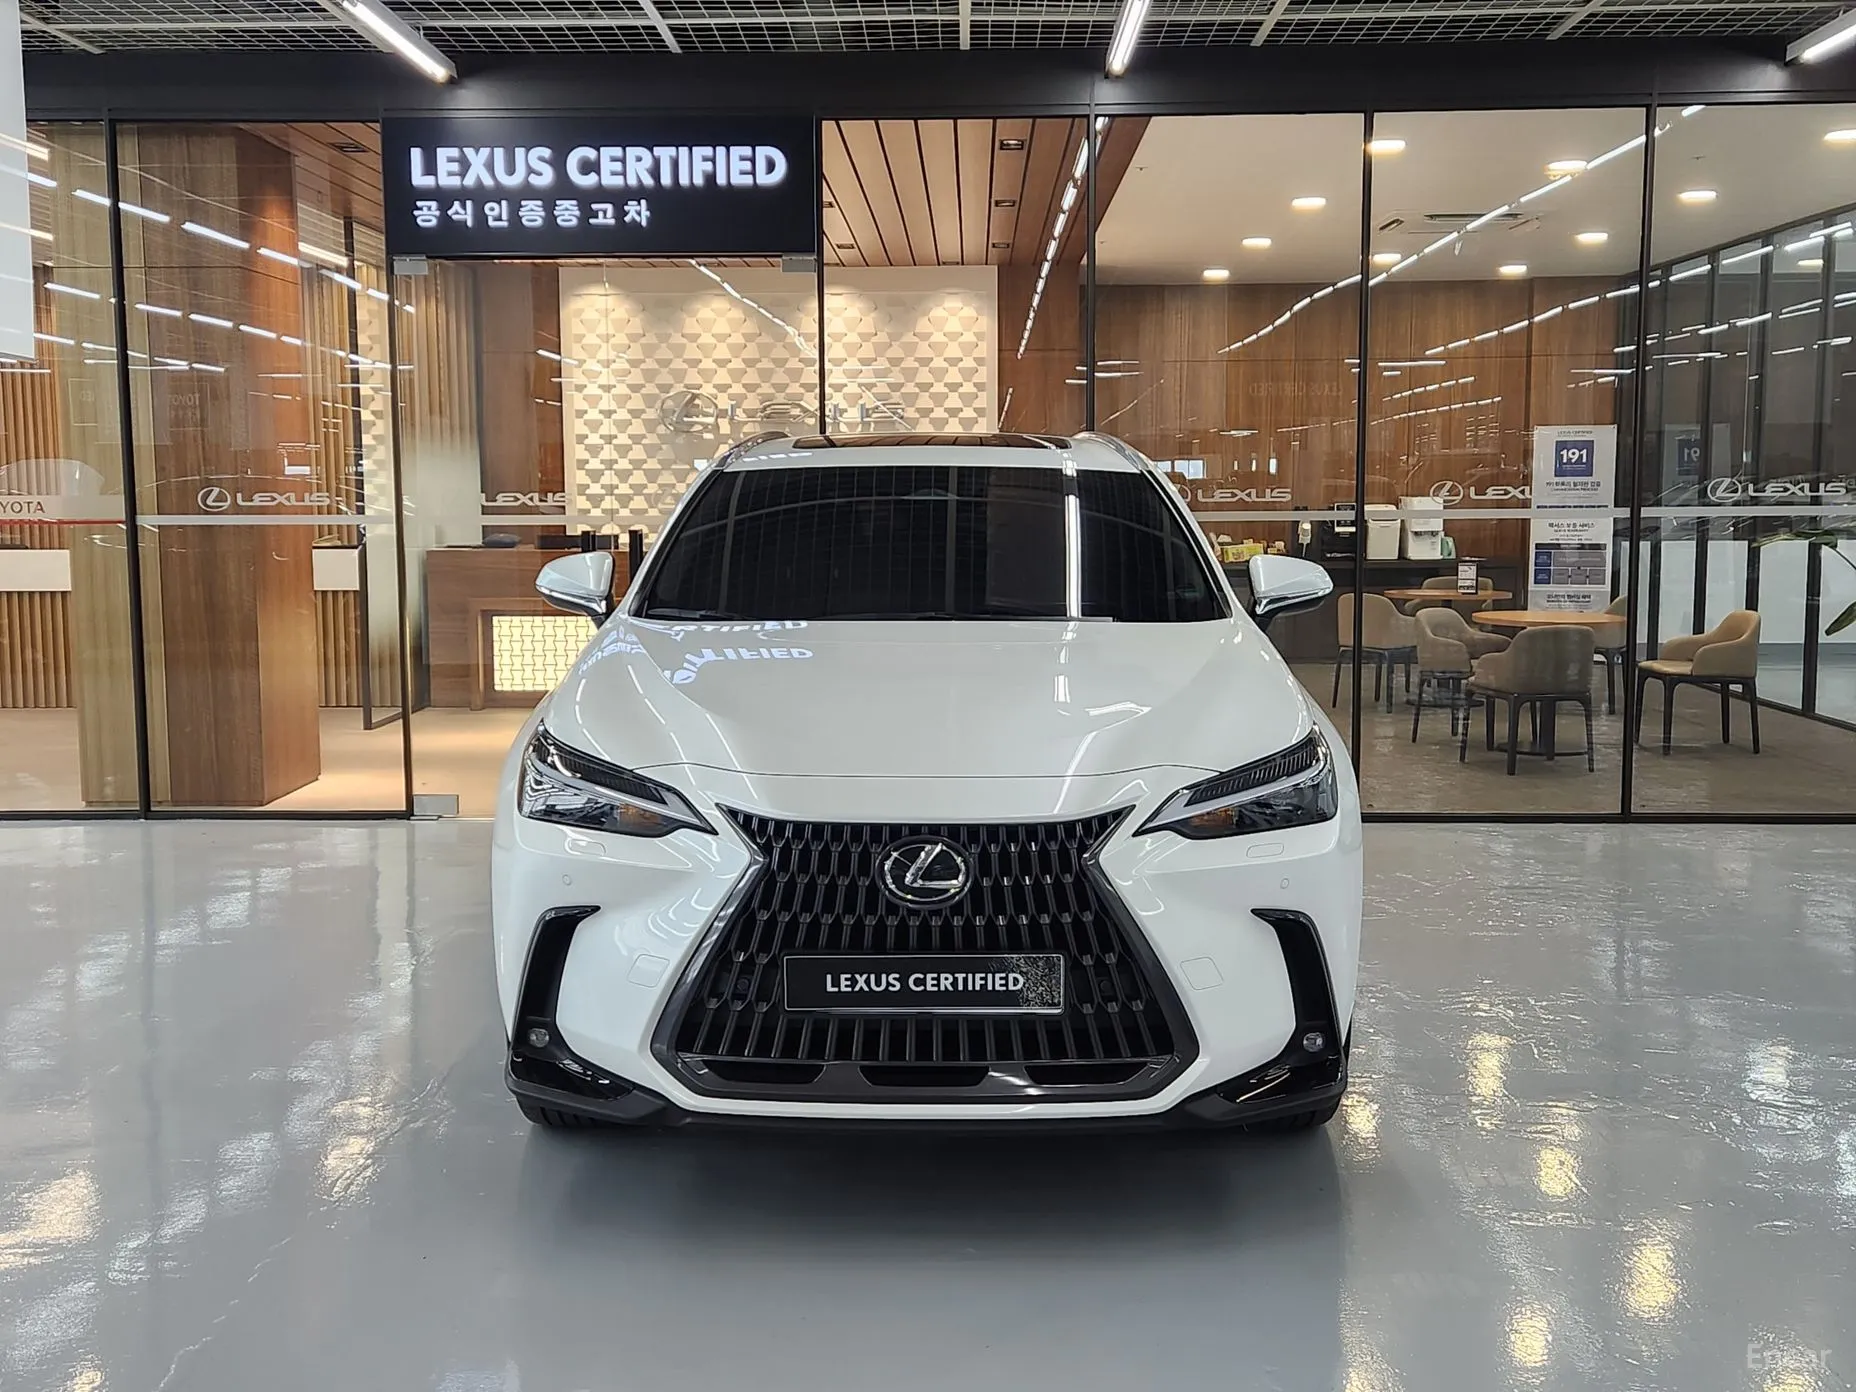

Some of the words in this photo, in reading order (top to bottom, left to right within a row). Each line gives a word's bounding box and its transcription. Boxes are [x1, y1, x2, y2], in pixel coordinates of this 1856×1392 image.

[410, 146, 554, 187] LEXUS
[565, 145, 788, 186] CERTIFIED
[412, 199, 651, 228] 공식인증중고차
[1560, 448, 1587, 463] 191
[1197, 488, 1292, 502] LEXUS
[1469, 486, 1533, 500] LEXU
[1748, 482, 1847, 497] LEXUS
[236, 492, 330, 506] LEXUS
[826, 973, 901, 992] LEXUS
[908, 972, 1024, 991] CERTIFIED
